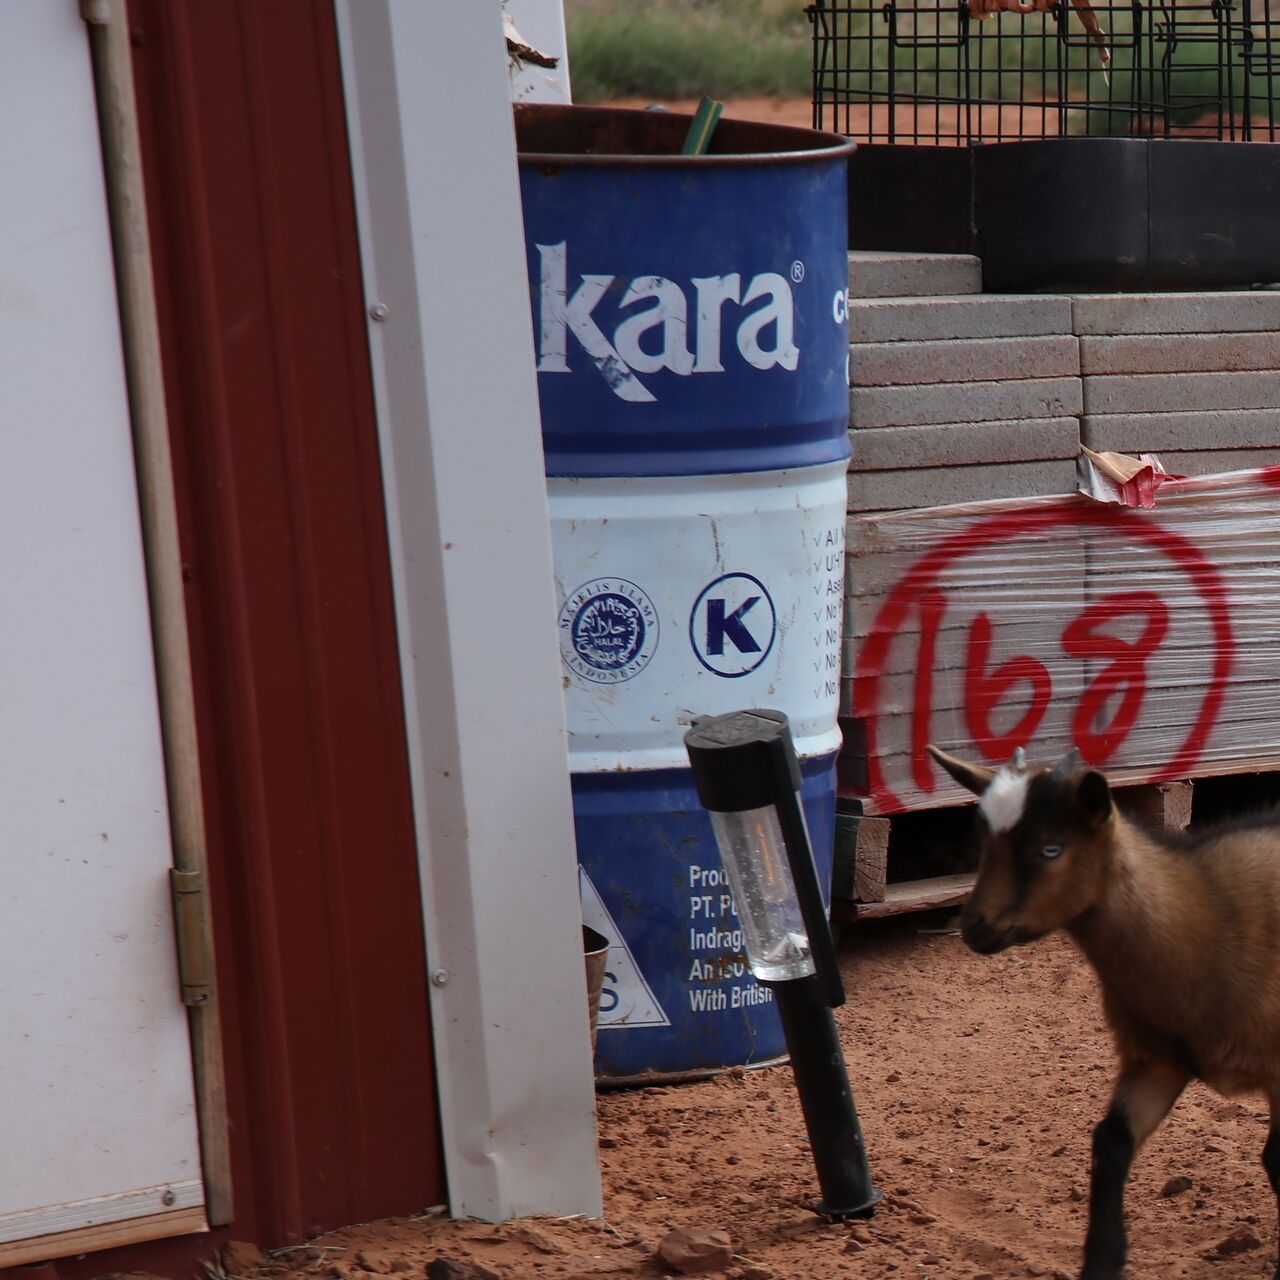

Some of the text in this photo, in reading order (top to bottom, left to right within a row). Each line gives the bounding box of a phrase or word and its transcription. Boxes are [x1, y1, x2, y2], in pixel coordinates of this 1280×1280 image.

[561, 583, 609, 629] MAJELIS
[620, 584, 655, 627] ULAMA
[706, 595, 763, 657] K
[594, 637, 625, 646] HALAL
[569, 653, 649, 681] INDONESIA
[909, 586, 1170, 795] 168
[690, 896, 716, 919] PT.
[688, 959, 714, 981] An
[689, 983, 773, 1012] With British
